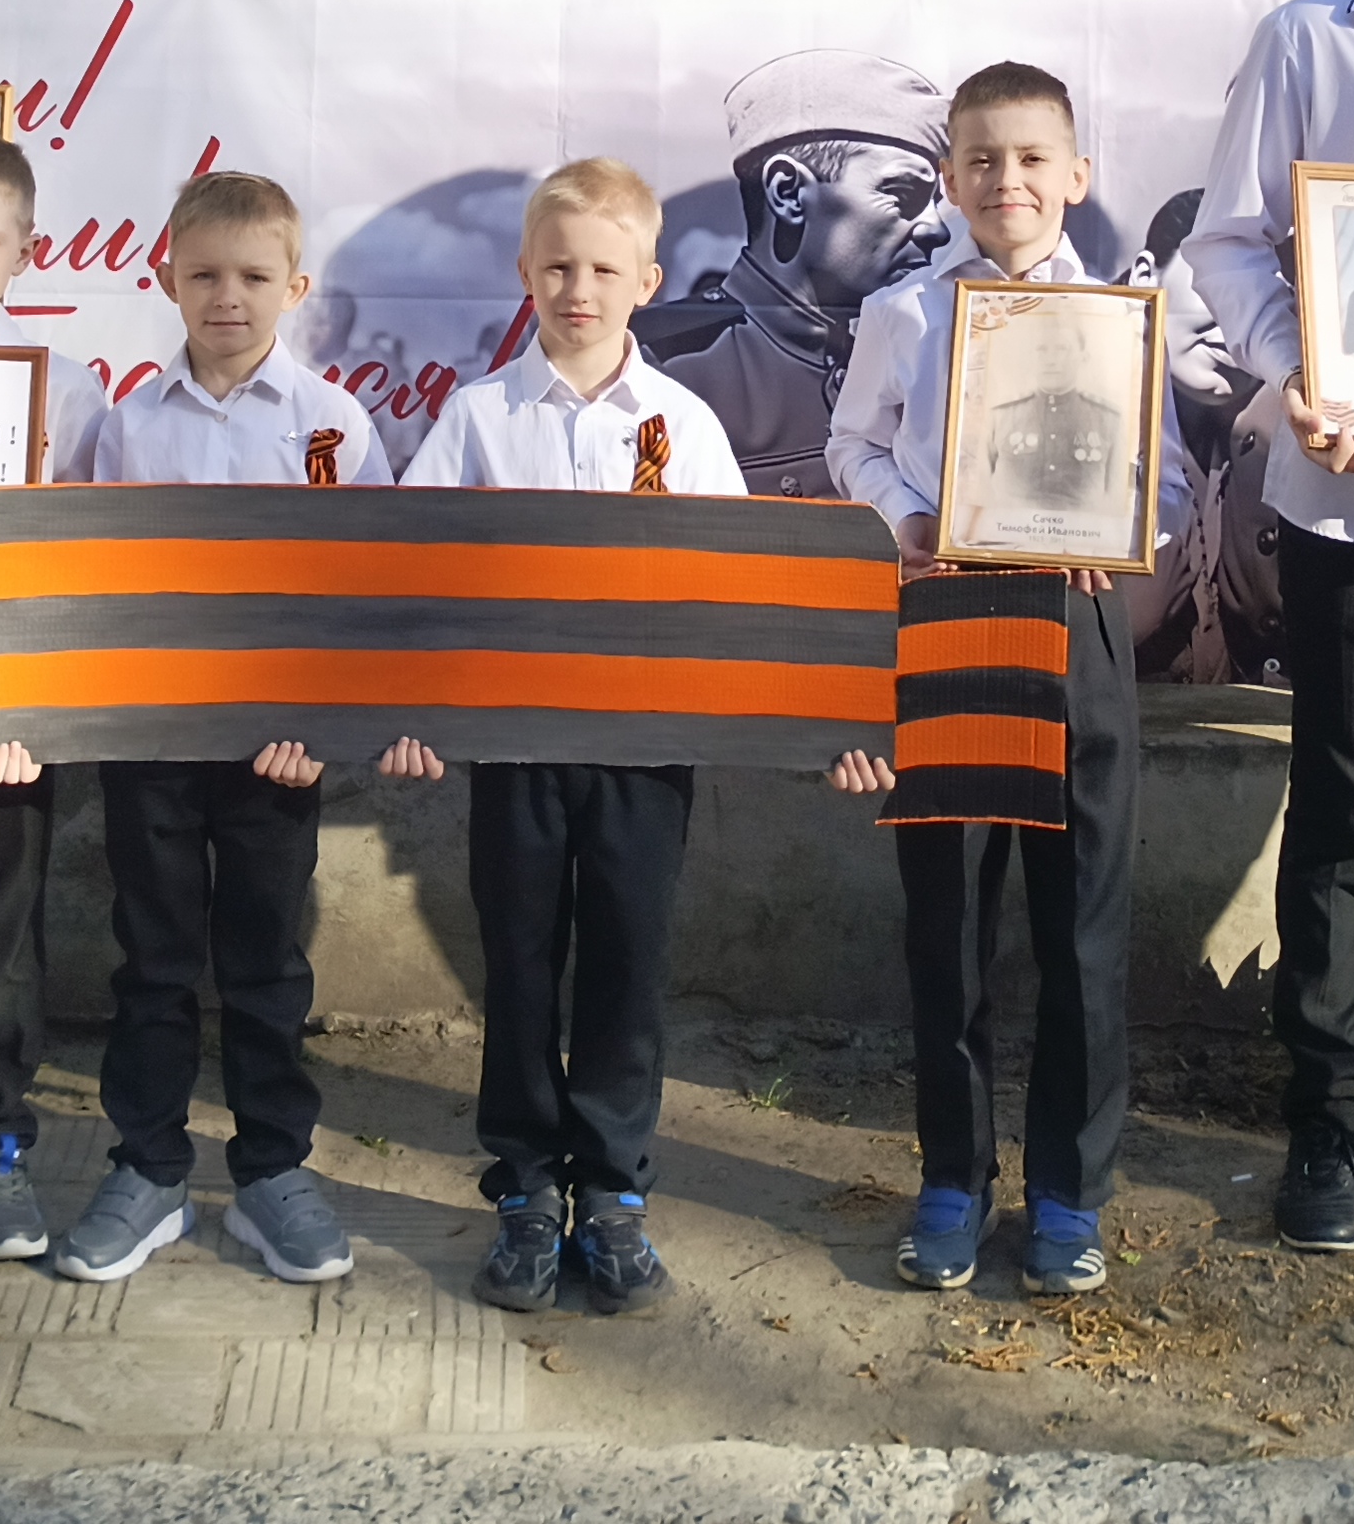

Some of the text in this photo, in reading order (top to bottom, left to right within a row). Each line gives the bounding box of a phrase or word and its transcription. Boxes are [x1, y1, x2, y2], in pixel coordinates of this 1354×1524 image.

[1033, 514, 1064, 525] Сачко
[997, 522, 1101, 538] Тимофей Иванович
